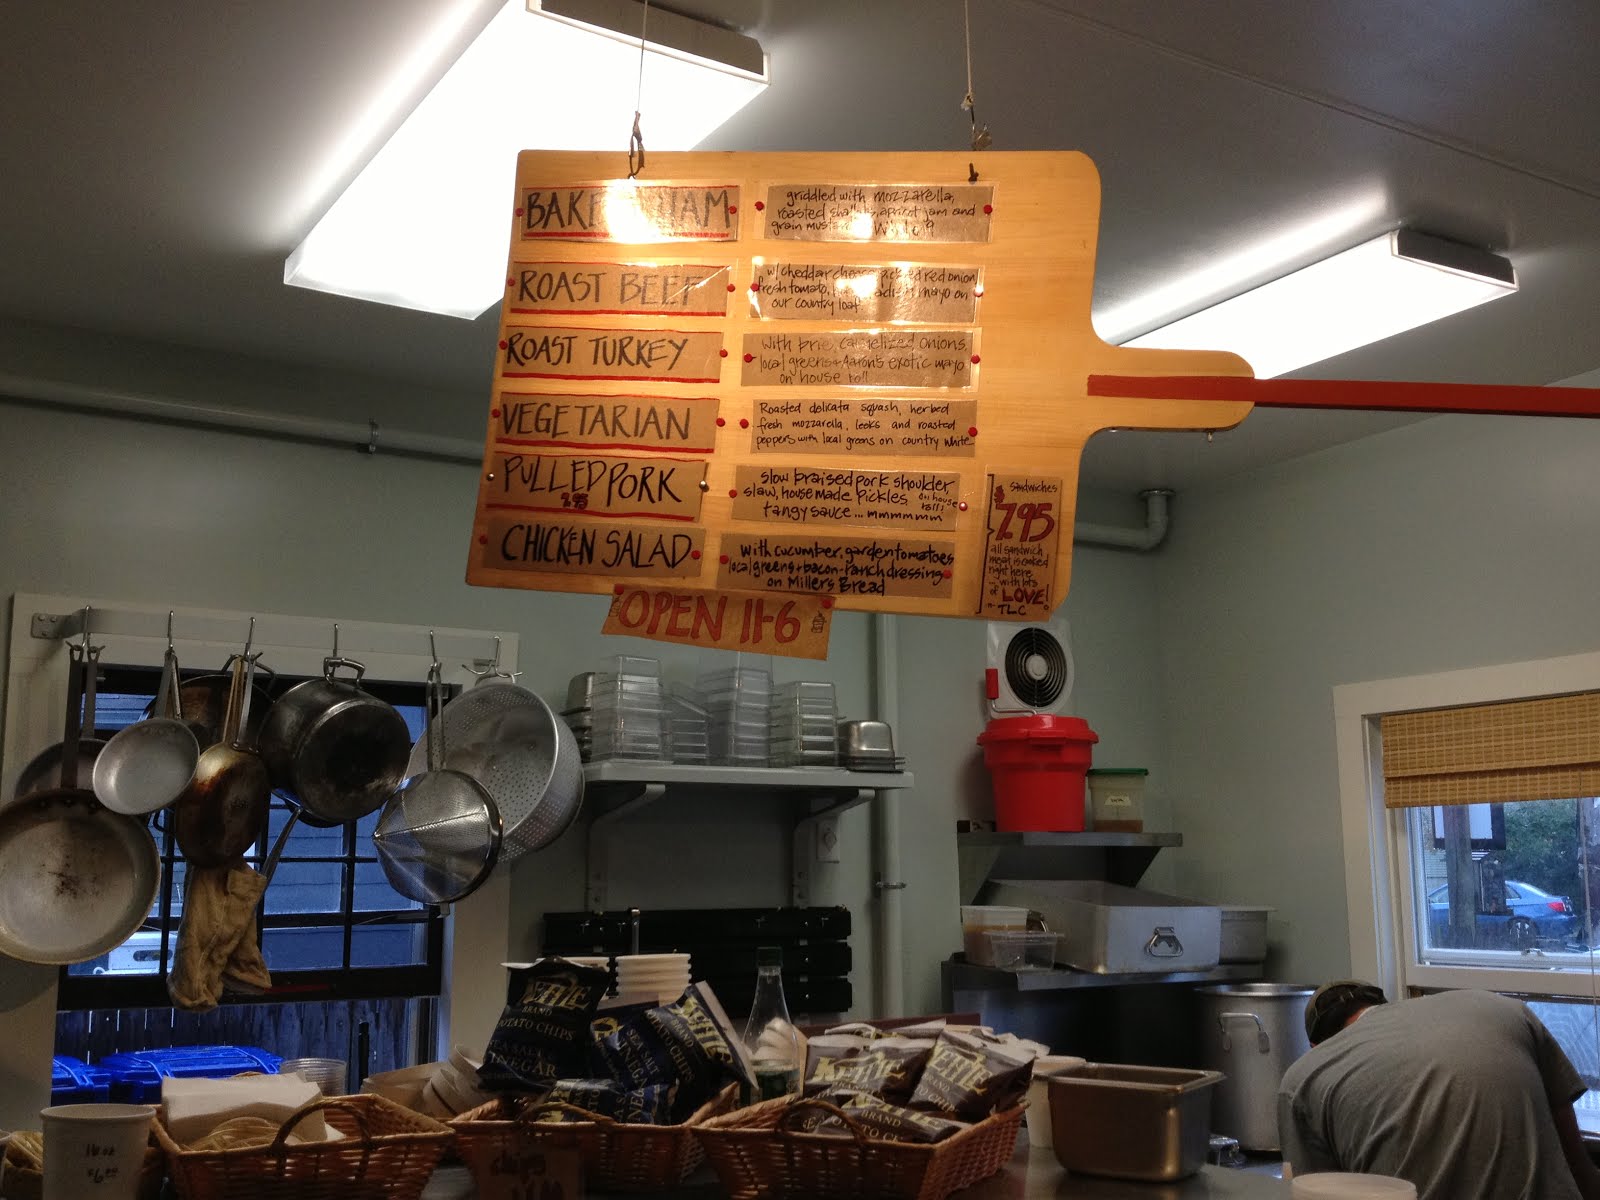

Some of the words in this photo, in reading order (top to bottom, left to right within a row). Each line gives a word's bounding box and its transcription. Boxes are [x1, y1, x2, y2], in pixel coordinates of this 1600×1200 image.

[786, 186, 837, 207] griddled
[840, 188, 866, 203] with
[526, 189, 620, 230] BAKE
[777, 203, 826, 220] roasted
[923, 208, 948, 223] jam
[951, 204, 976, 217] and
[771, 220, 803, 236] grain
[924, 270, 945, 283] red
[518, 270, 607, 303] ROAST
[620, 272, 704, 306] BEEF
[757, 275, 785, 295] fresh
[919, 286, 951, 305] mayo
[953, 290, 969, 300] on
[771, 297, 793, 308] our
[795, 298, 834, 316] country
[505, 332, 578, 367] ROAST
[589, 336, 689, 371] TURKEY
[760, 352, 785, 373] local
[888, 353, 932, 370] exotic
[934, 359, 965, 375] mayo
[779, 373, 793, 385] on
[799, 370, 841, 384] house
[759, 402, 802, 415] Roasted
[809, 400, 850, 414] delicata
[910, 403, 950, 415] herbed
[502, 402, 691, 441] VEGETARIAN
[756, 416, 783, 434] fresh
[855, 419, 881, 430] leeks
[891, 418, 911, 429] and
[917, 419, 956, 431] roasted
[756, 434, 796, 450] peppers
[797, 434, 818, 444] with
[822, 432, 842, 444] local
[846, 435, 876, 451] greens
[879, 437, 894, 445] on
[901, 433, 939, 451] country
[944, 435, 975, 448] white
[503, 455, 607, 493] PULLED
[606, 462, 683, 507] PORK
[760, 468, 789, 484] slow
[793, 467, 853, 487] braised
[932, 491, 959, 508] house
[763, 500, 808, 522] tangy
[501, 523, 597, 567] CHICKEN
[601, 529, 693, 569] SALAD
[845, 541, 894, 564] garden
[990, 543, 1003, 555] all
[1003, 543, 1043, 557] sandwich
[728, 556, 751, 575] local
[886, 559, 945, 586] dressing
[766, 577, 782, 587] on
[838, 575, 886, 597] Bread
[618, 590, 729, 642] OPEN
[499, 1017, 535, 1030] OTATO
[535, 1021, 576, 1042] CHIPS
[488, 1050, 559, 1078] INEGAR
[861, 1108, 903, 1128] BRAND
